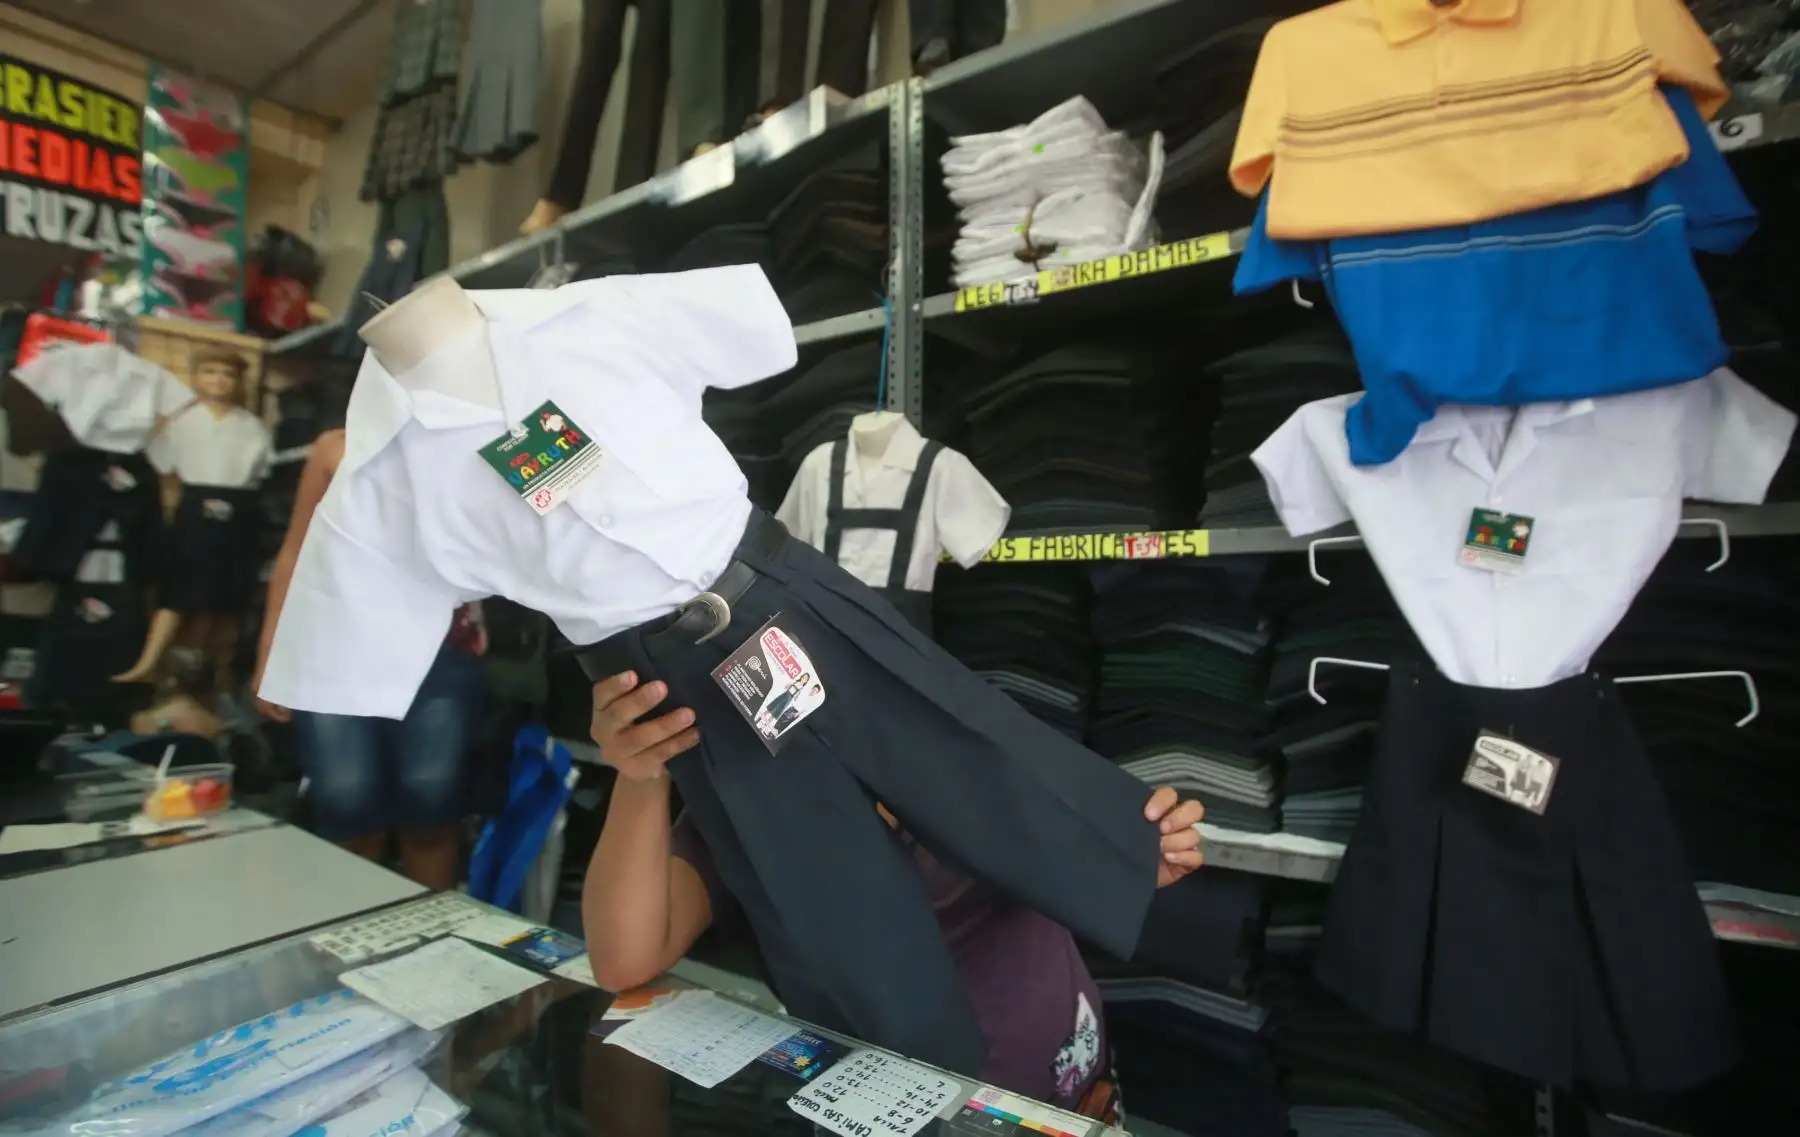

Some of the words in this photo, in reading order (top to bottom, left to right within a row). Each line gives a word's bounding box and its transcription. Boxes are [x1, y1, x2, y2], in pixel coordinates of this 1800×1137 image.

[1119, 239, 1210, 276] DAMAS
[1029, 529, 1197, 561] FABRICAES
[764, 633, 799, 679] ESCOLAR
[873, 1115, 908, 1134] TALLA
